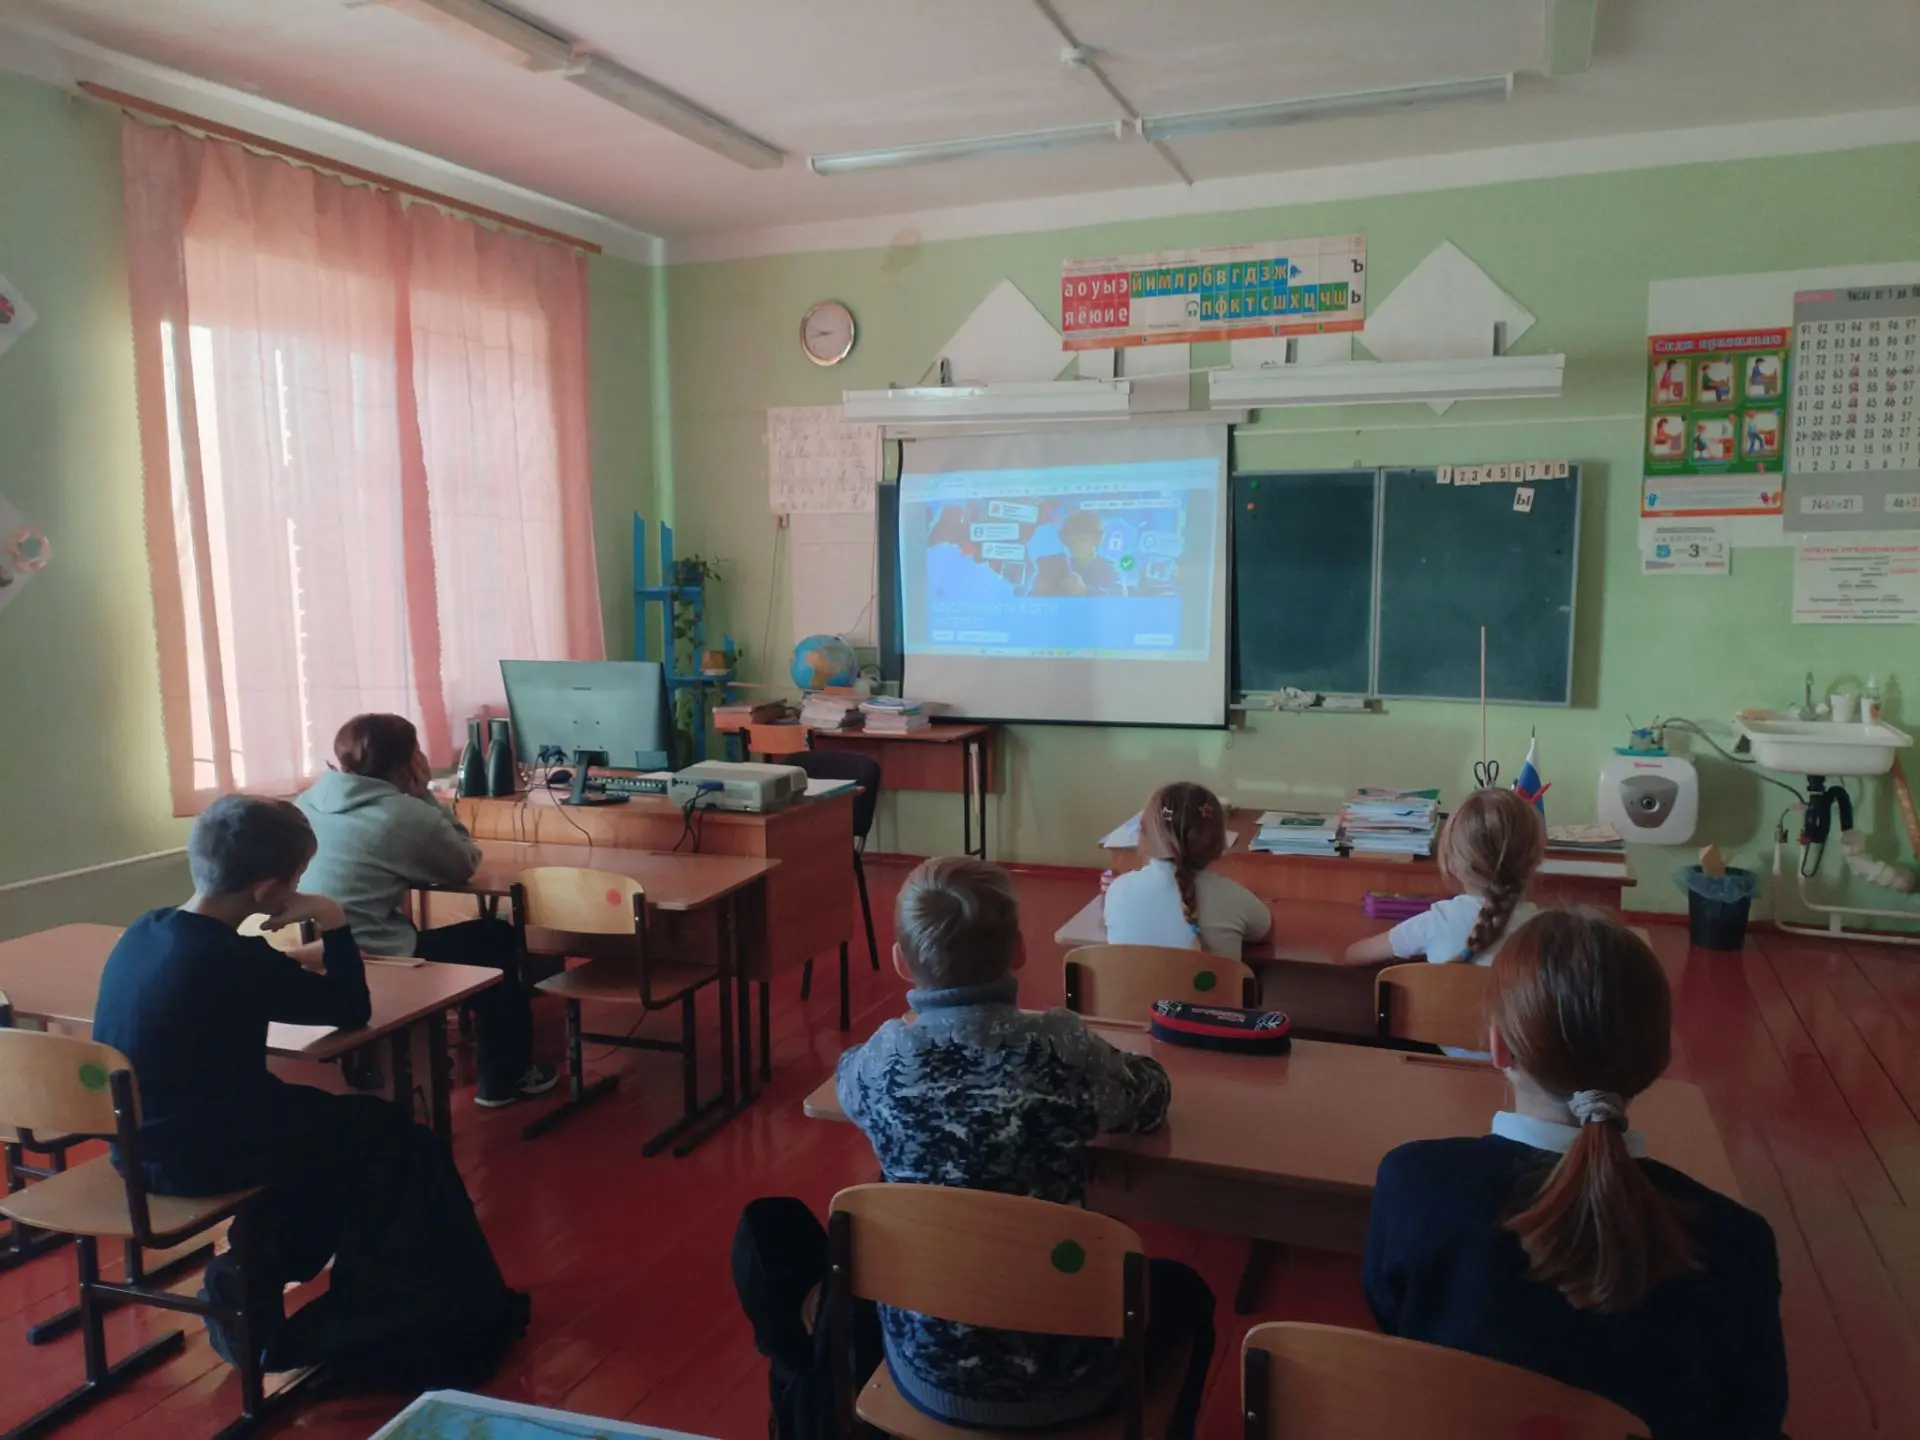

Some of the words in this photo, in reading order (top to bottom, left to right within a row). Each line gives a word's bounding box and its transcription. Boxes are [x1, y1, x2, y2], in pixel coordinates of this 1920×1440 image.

[1444, 470, 1447, 480] 1
[1460, 472, 1465, 481] 2
[1472, 471, 1477, 481] 3
[1486, 469, 1492, 478] 4
[1500, 468, 1505, 478] 5
[1515, 468, 1520, 477] 6
[1530, 465, 1535, 475] 7
[1545, 465, 1550, 475] 8
[1559, 464, 1565, 474] 9
[1688, 544, 1699, 558] 3
